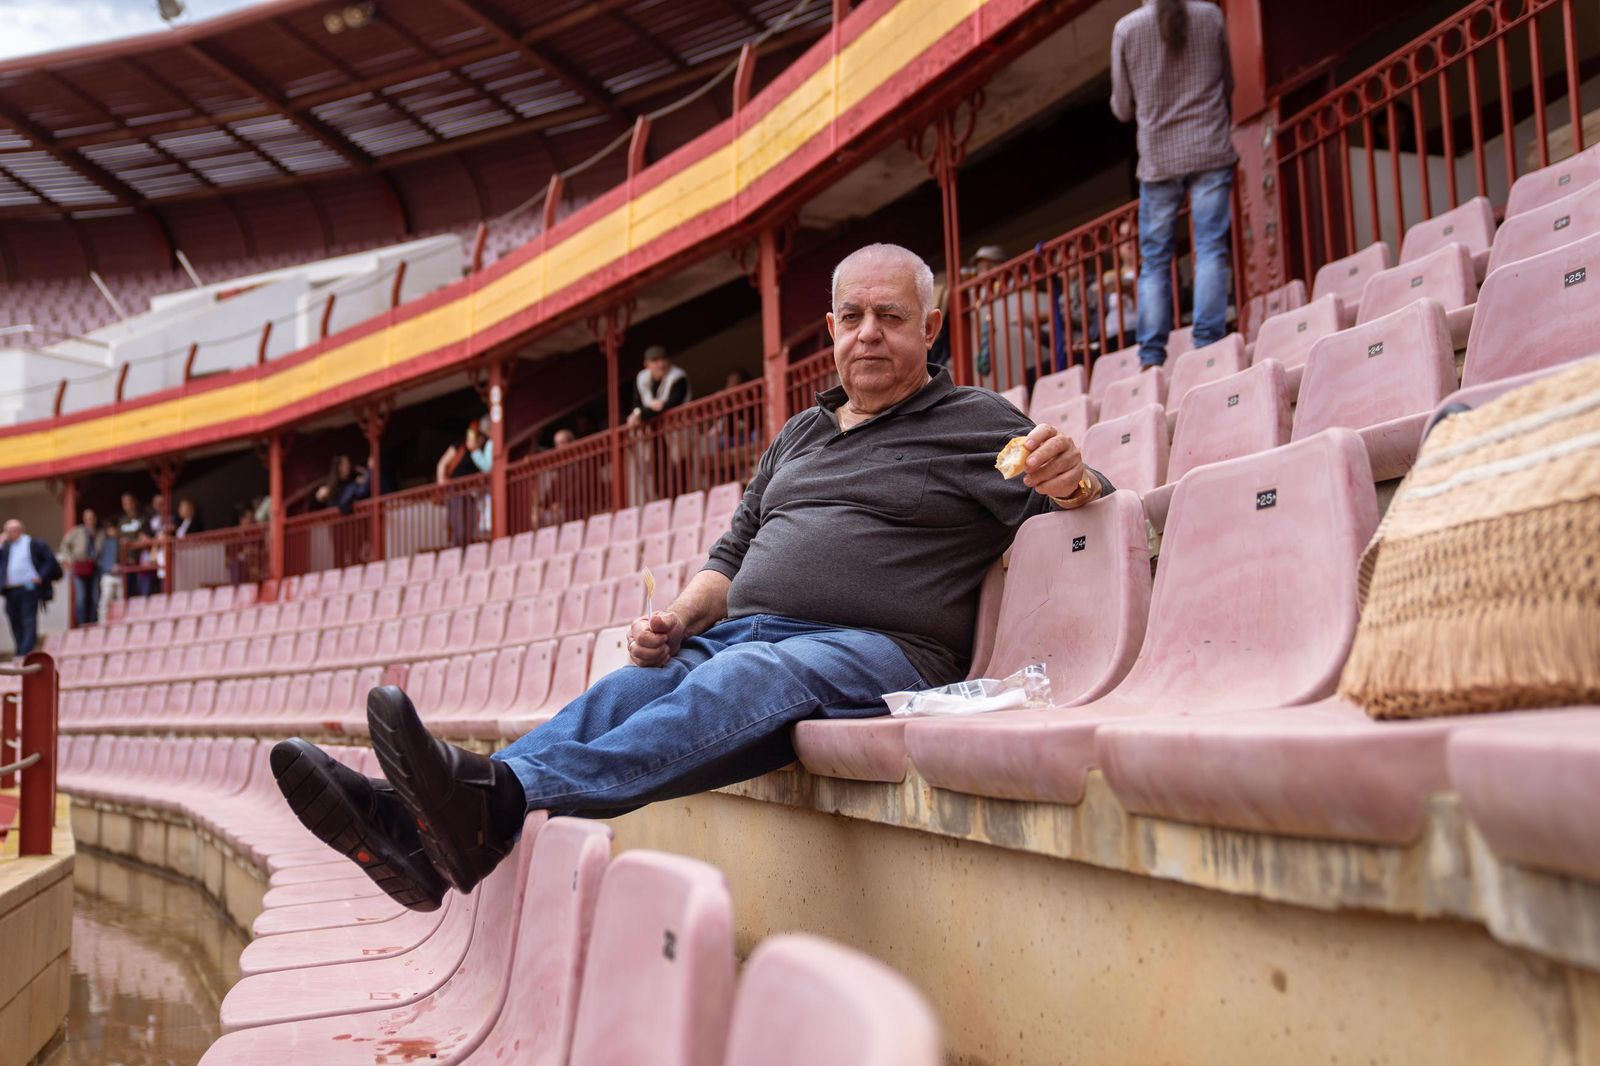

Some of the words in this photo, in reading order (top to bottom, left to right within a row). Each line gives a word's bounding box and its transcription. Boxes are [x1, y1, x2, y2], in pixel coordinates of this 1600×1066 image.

[1567, 270, 1583, 285] 25
[1259, 492, 1275, 507] 25
[1073, 538, 1085, 550] 24
